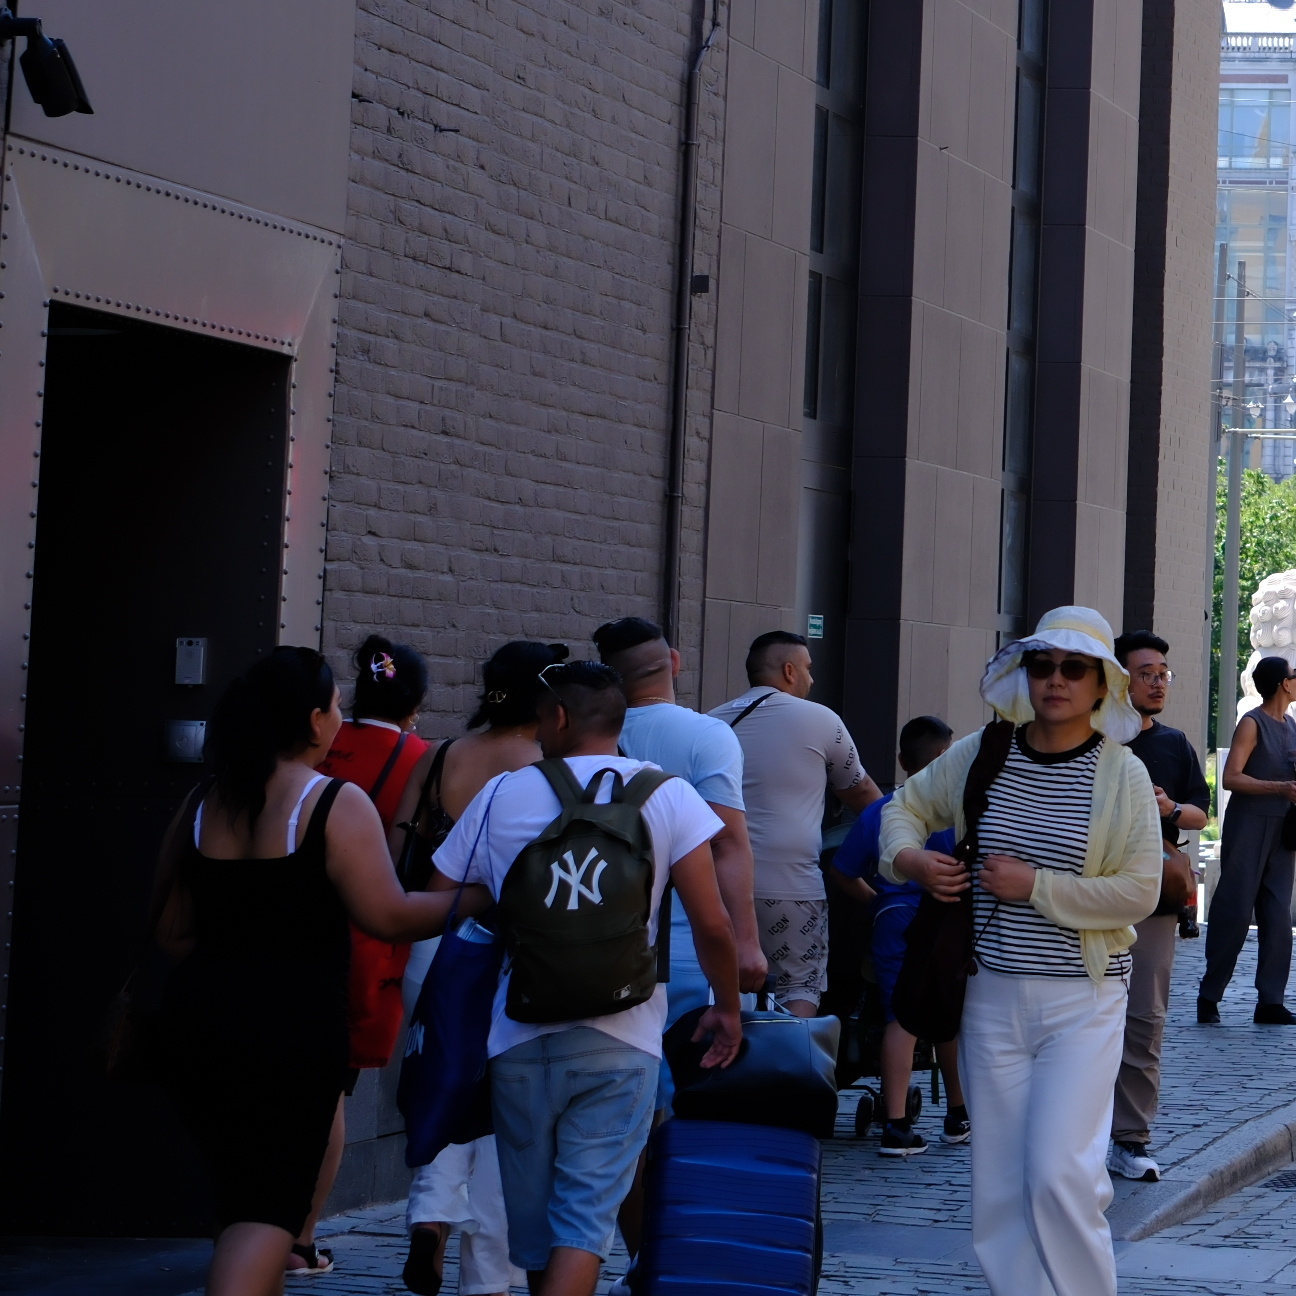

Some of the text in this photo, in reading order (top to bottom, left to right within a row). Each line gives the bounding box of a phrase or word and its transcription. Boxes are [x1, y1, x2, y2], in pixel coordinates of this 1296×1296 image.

[843, 745, 854, 770] ICON
[848, 771, 861, 789] CON
[544, 846, 608, 910] NY
[768, 915, 790, 936] ICON
[800, 914, 819, 936] ICON
[769, 943, 791, 964] ICON
[800, 942, 819, 964] ICON
